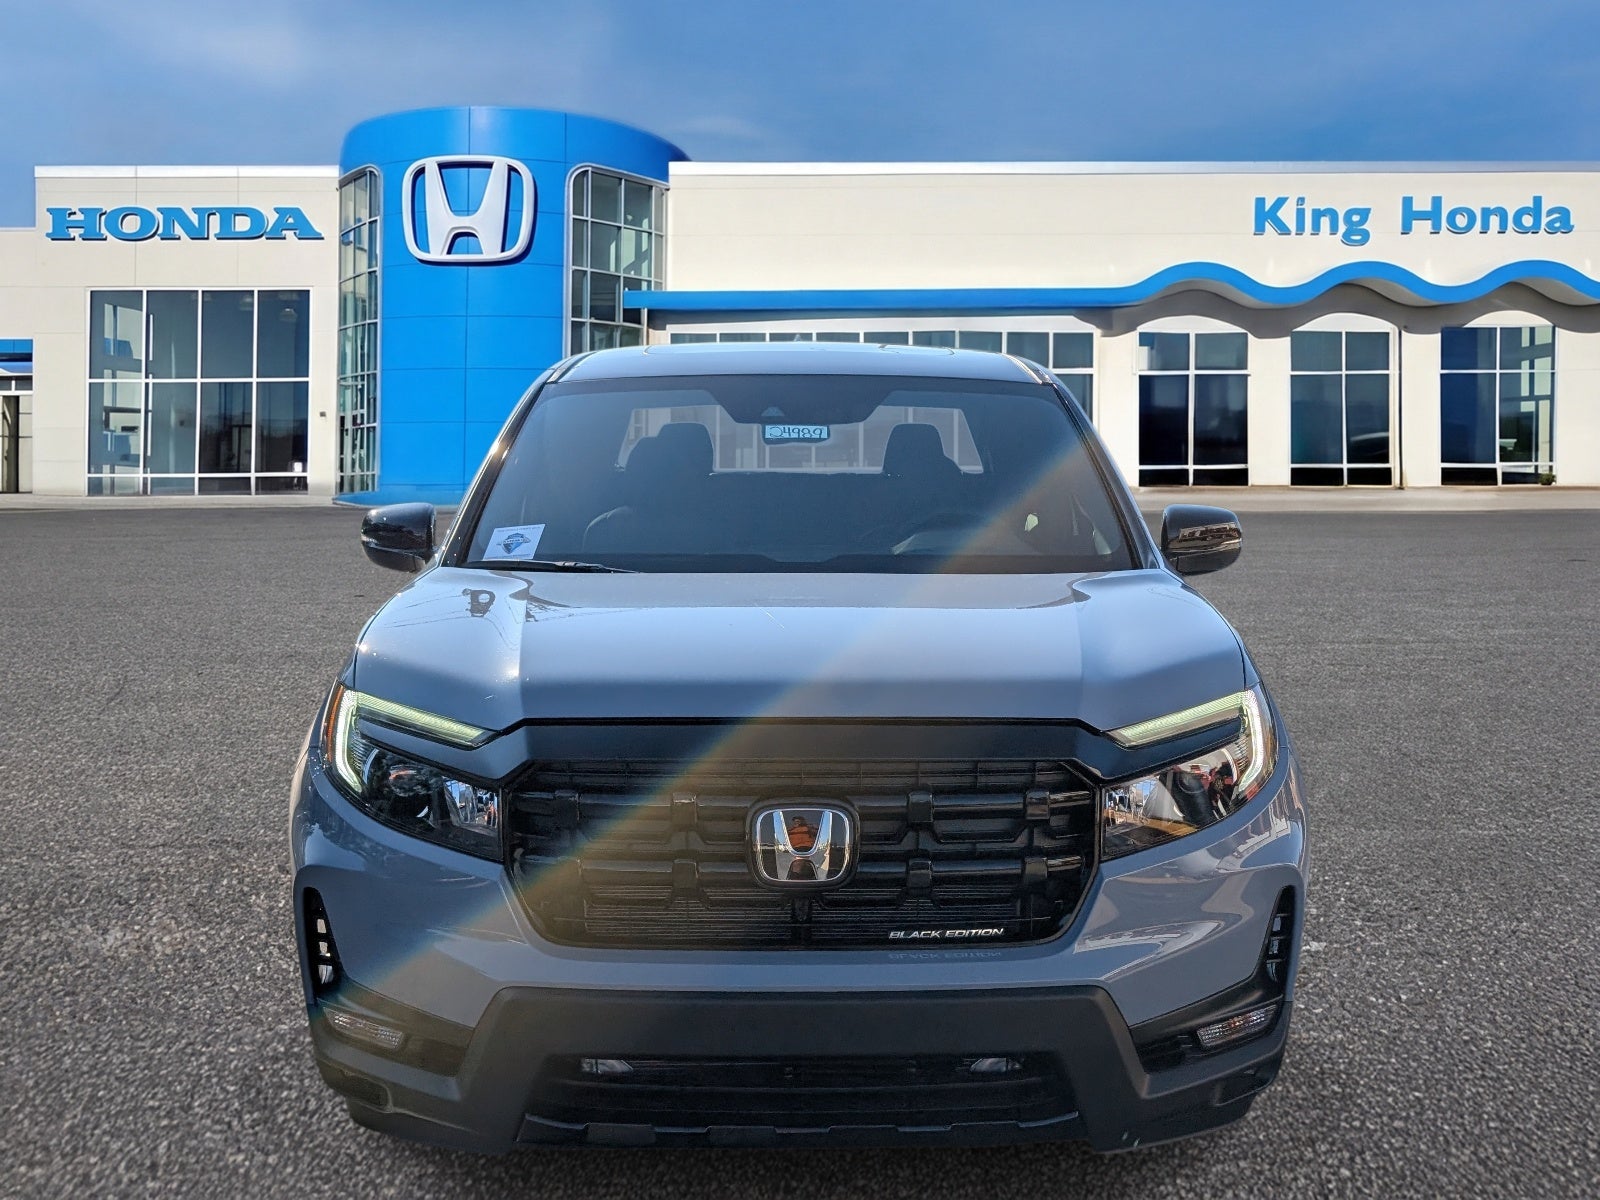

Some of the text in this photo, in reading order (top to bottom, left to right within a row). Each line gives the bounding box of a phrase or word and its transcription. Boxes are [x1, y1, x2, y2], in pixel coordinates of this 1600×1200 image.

[45, 205, 324, 241] HONDA
[1253, 195, 1574, 247] King Honda
[888, 928, 1005, 940] BLACK EDITION
